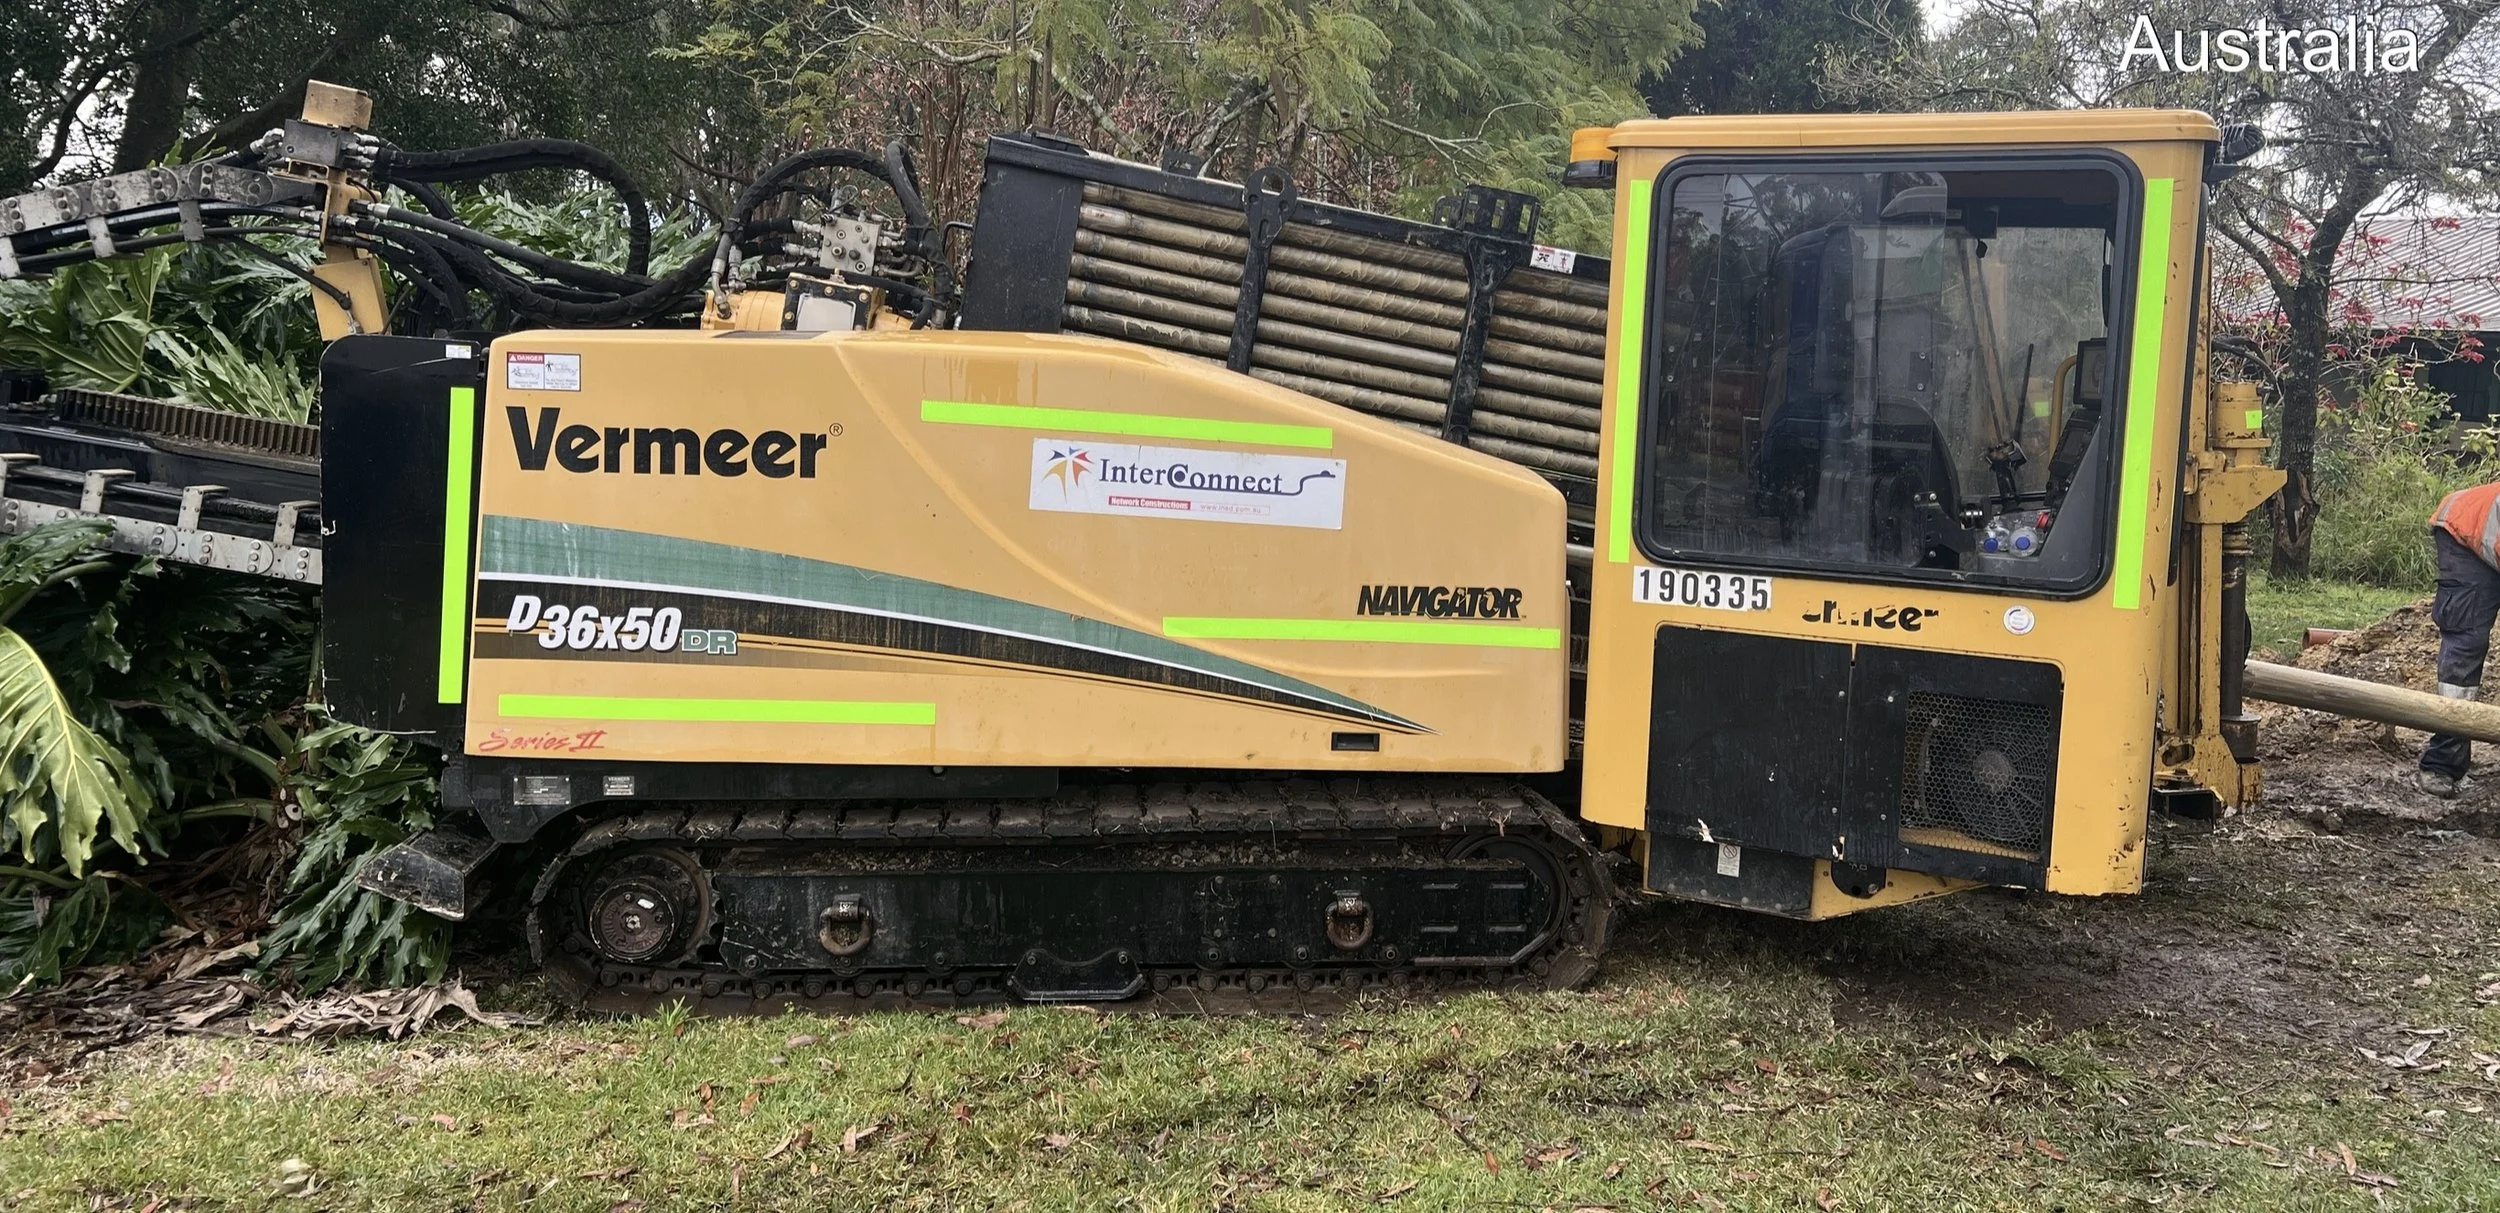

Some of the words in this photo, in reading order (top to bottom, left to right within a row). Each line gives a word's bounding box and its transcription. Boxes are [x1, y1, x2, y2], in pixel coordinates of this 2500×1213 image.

[516, 354, 543, 362] DANGER
[1099, 458, 1283, 494] InterConnect
[1111, 497, 1139, 506] Network
[1140, 498, 1188, 509] Constructions
[1356, 585, 1523, 618] NAVIGATOR
[1640, 569, 1769, 611] 190335
[506, 594, 683, 651] D36x50
[681, 629, 737, 655] DR
[478, 728, 571, 753] Series
